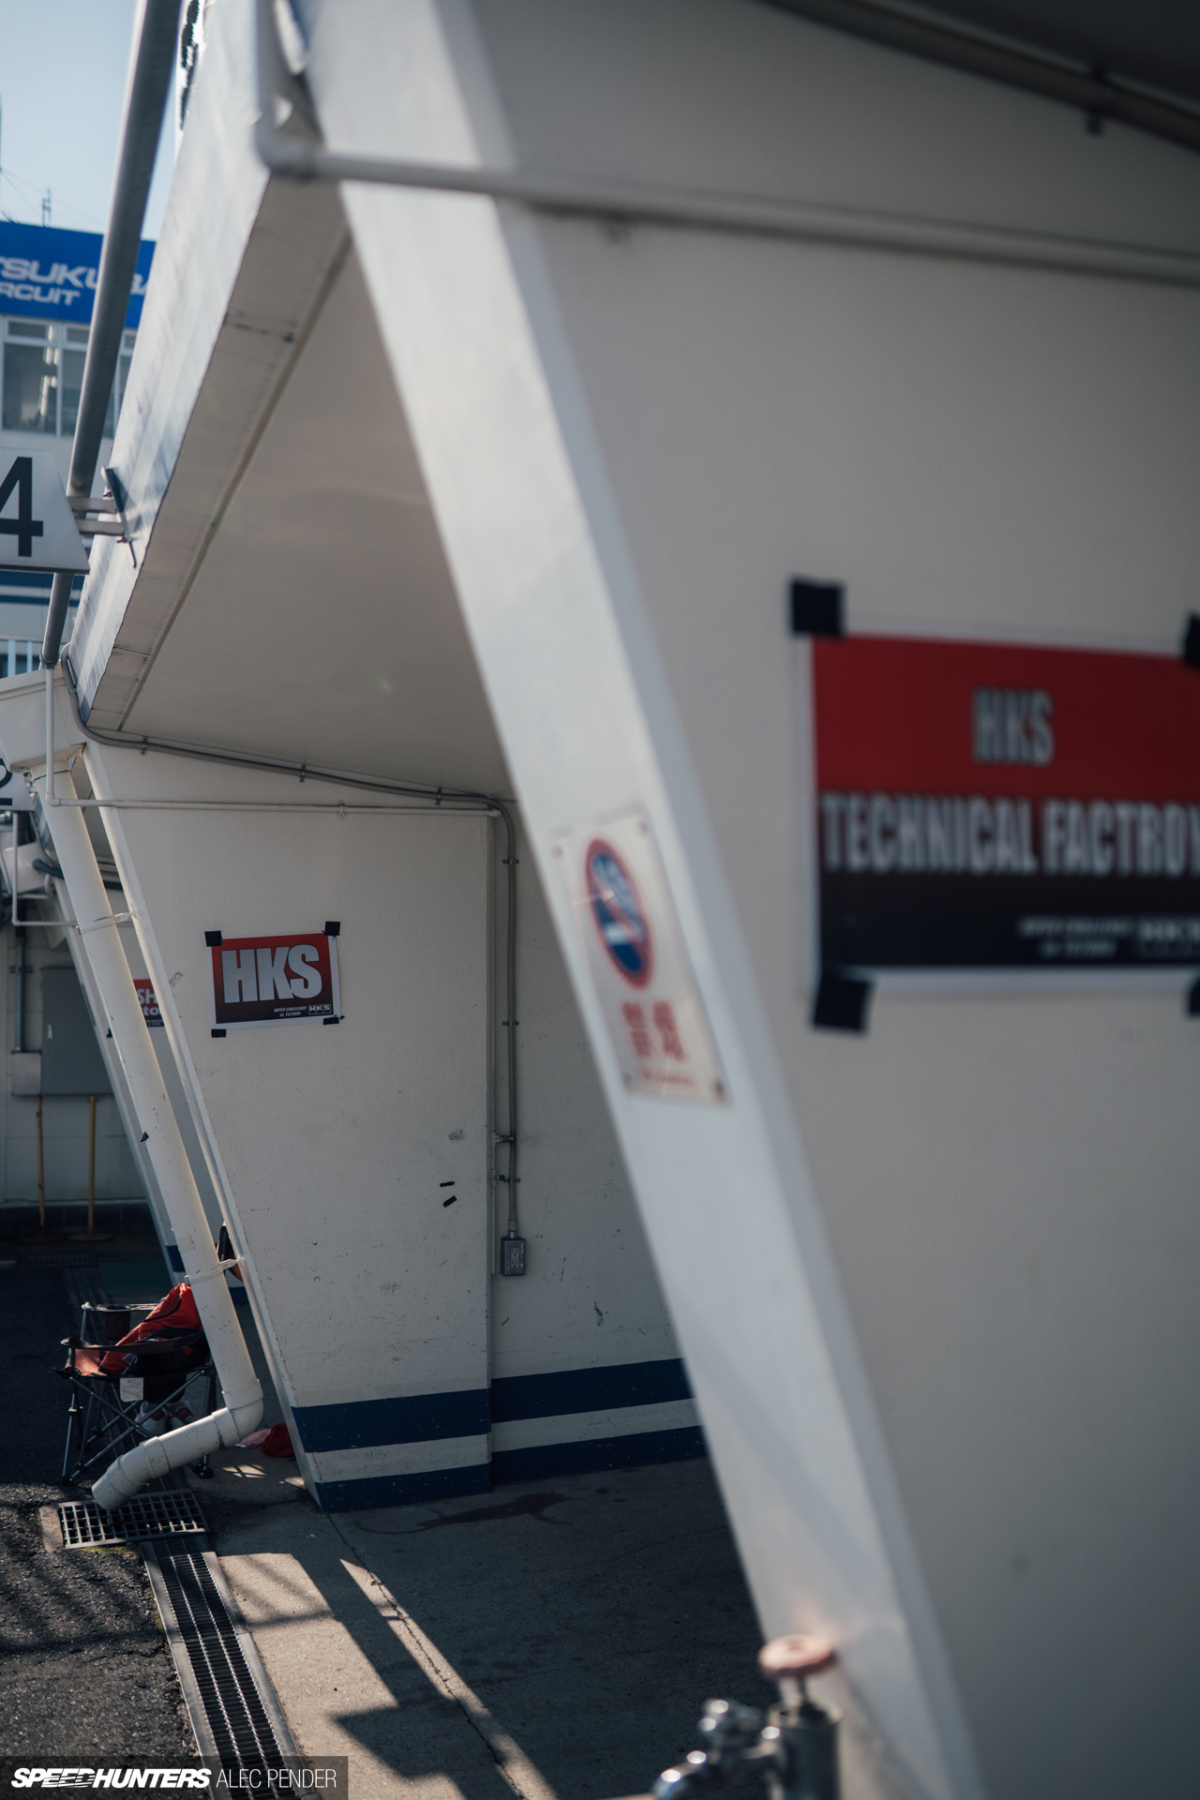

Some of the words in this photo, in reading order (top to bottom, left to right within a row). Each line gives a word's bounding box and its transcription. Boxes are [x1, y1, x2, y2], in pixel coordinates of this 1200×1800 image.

[972, 686, 1056, 767] HKS
[820, 791, 1038, 874] TECHNICAL
[221, 944, 323, 1003] HKS
